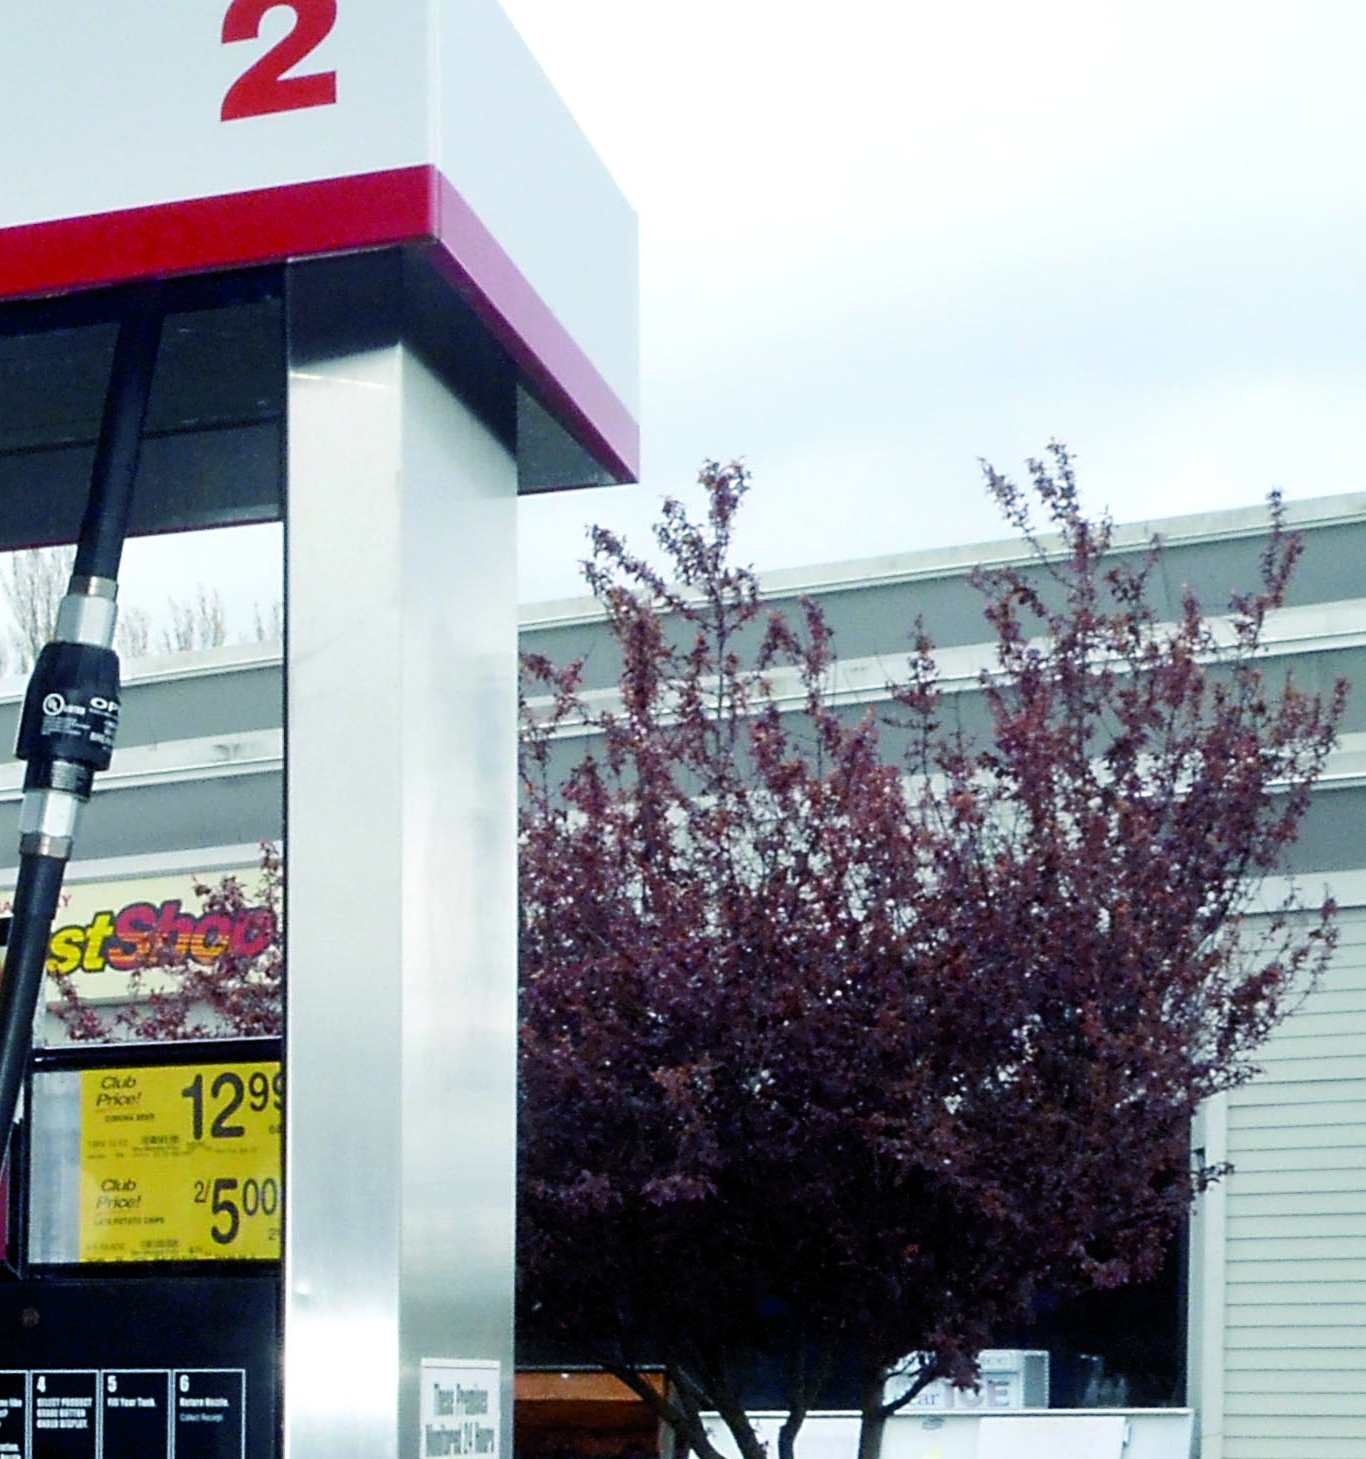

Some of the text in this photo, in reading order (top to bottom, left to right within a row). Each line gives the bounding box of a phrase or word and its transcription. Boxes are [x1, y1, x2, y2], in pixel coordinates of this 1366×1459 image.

[219, 0, 337, 121] 2
[101, 1075, 137, 1089] Club
[96, 1091, 142, 1107] Price!
[101, 1178, 137, 1192] Club
[96, 1195, 142, 1208] Price!
[37, 1376, 46, 1393] 4
[107, 1375, 117, 1393] 5
[179, 1374, 190, 1392] 6
